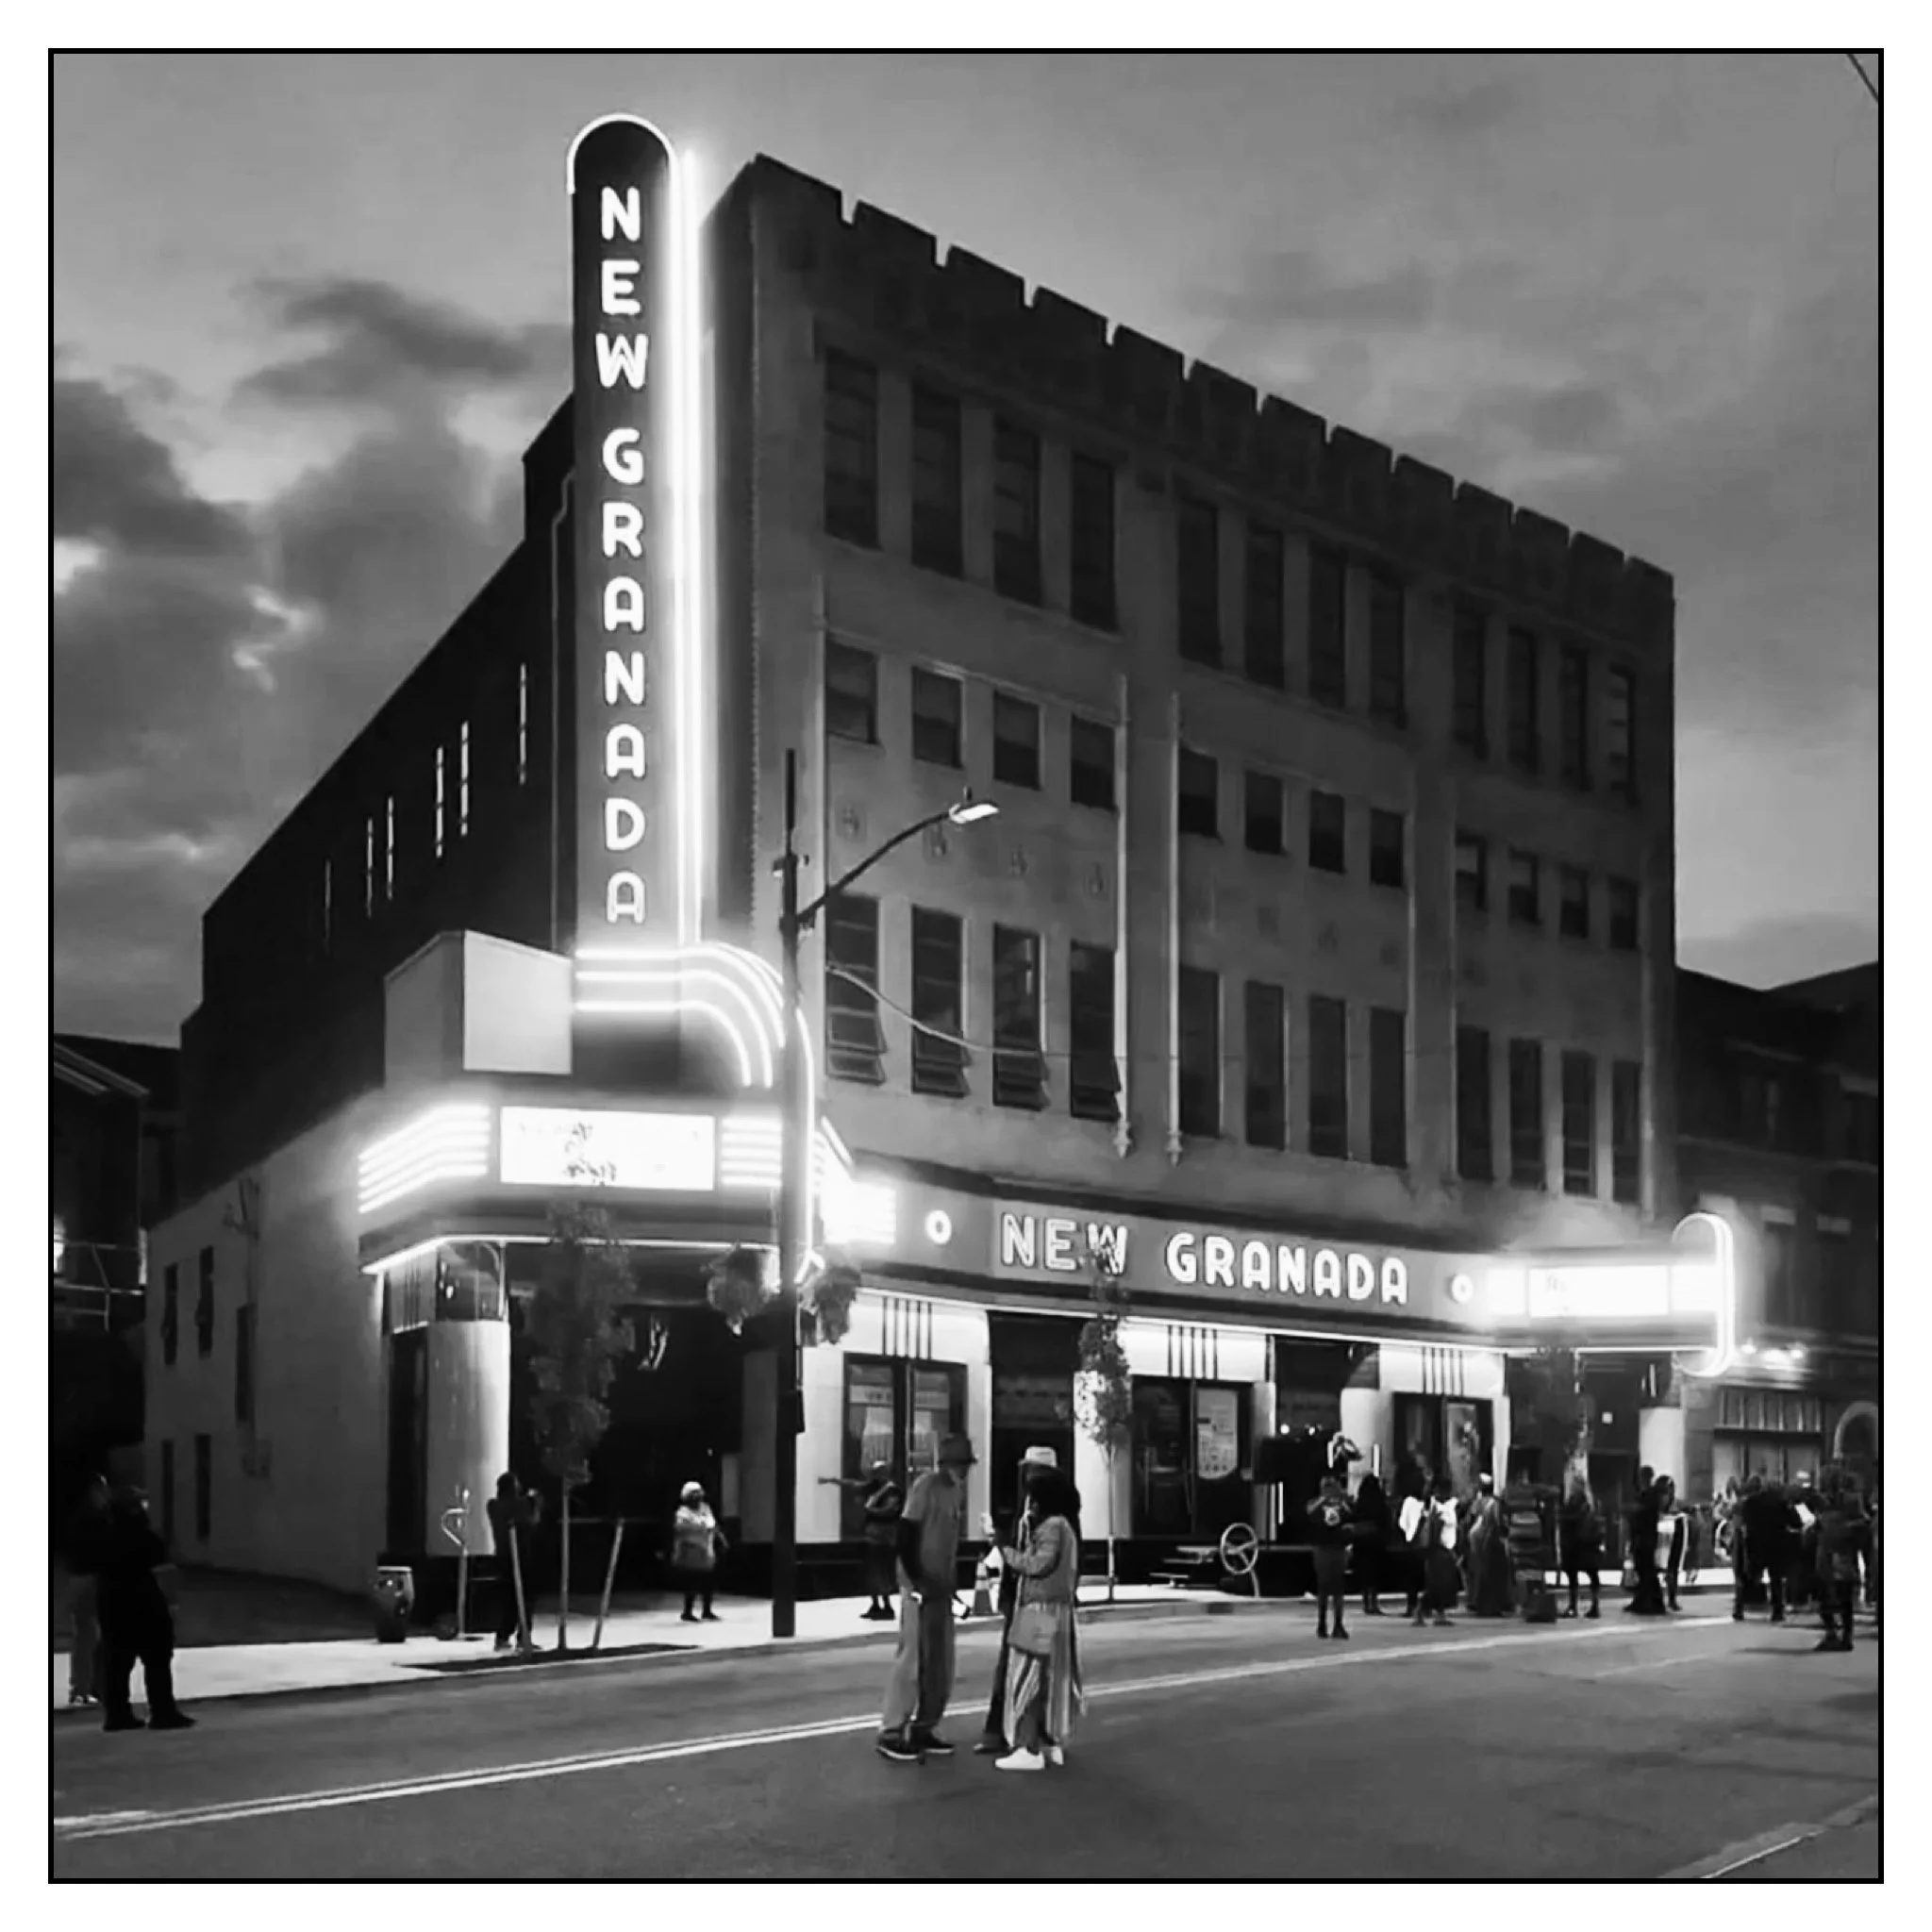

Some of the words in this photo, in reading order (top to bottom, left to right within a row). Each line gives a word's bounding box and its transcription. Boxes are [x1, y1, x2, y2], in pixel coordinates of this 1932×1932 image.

[595, 186, 648, 390] NEW
[601, 427, 646, 924] GRANADA
[1001, 1213, 1128, 1275] NEW
[1166, 1232, 1408, 1305] GRANADA
